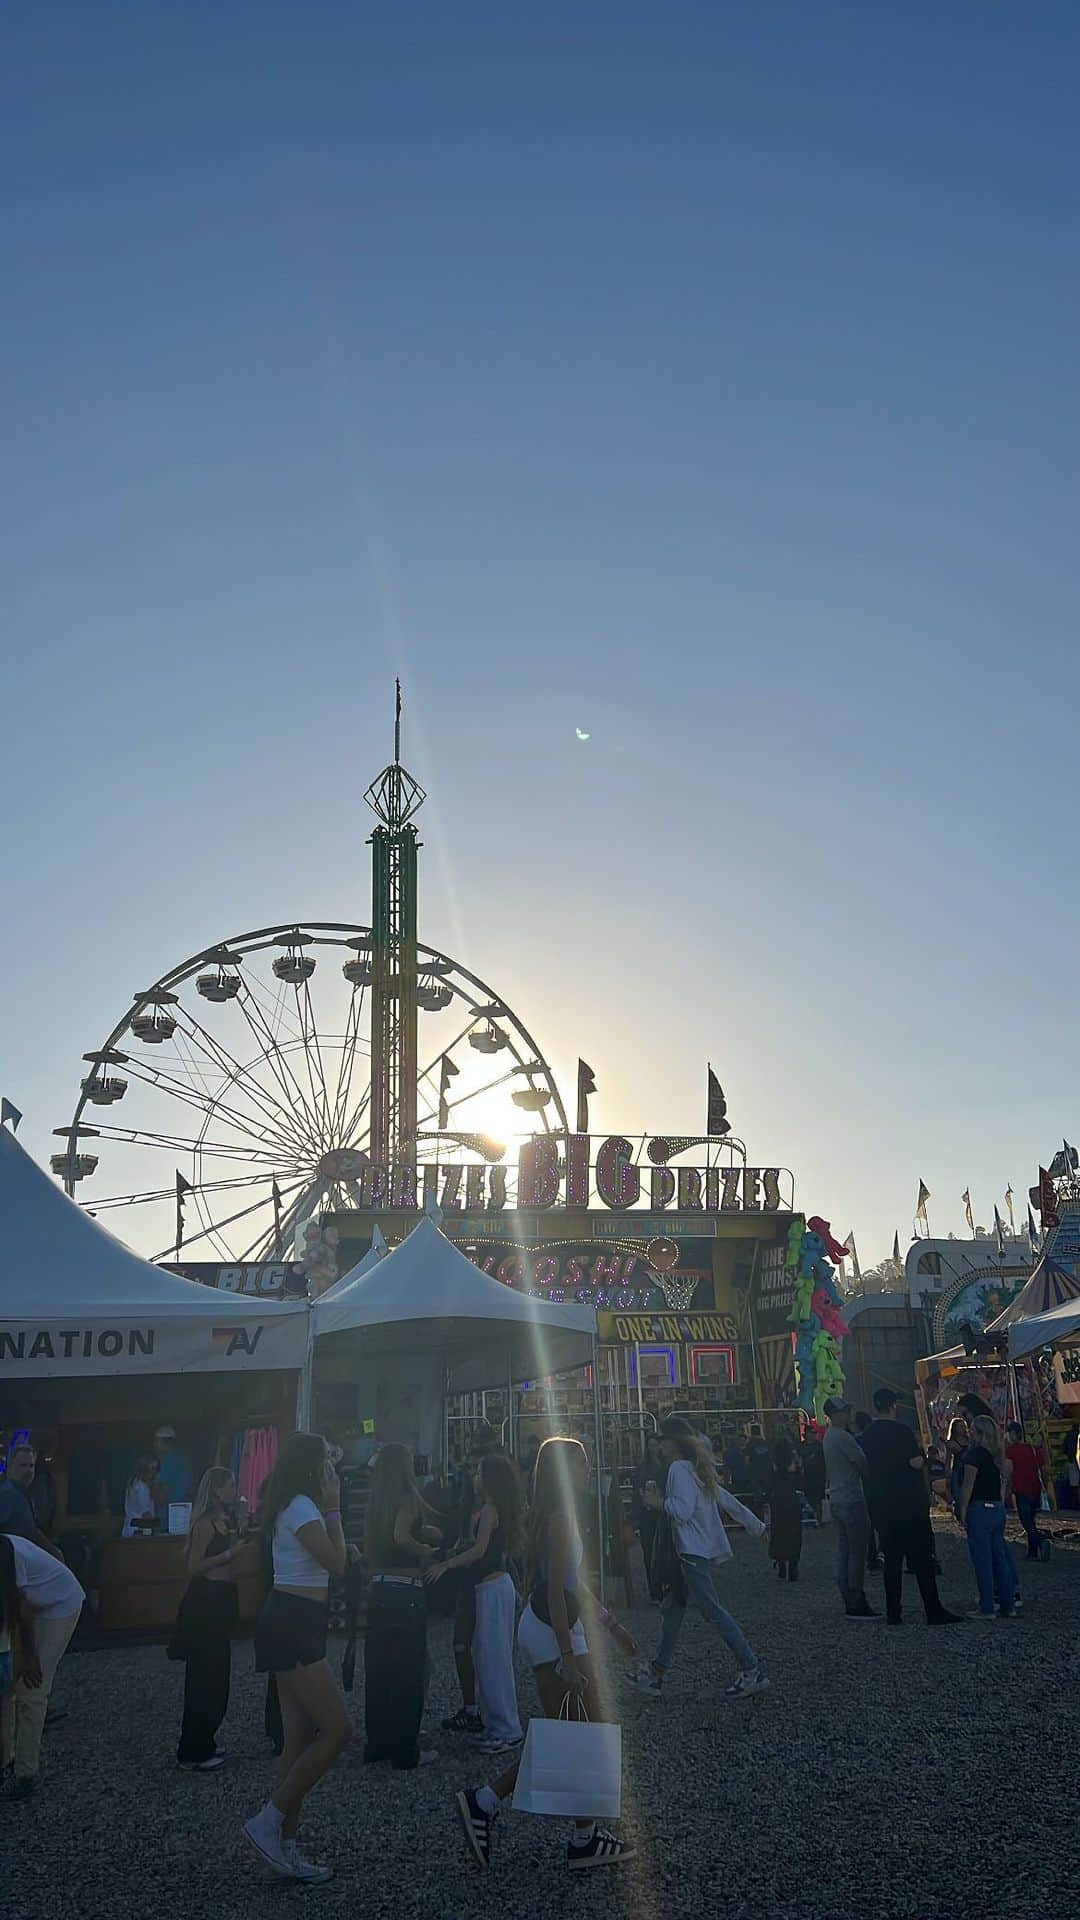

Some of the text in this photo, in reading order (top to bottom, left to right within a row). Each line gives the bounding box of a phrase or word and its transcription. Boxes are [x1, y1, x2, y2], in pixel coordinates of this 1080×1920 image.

[361, 1134, 780, 1211] PRIZES BIG PRIZES
[216, 1266, 286, 1291] BIG
[616, 1317, 738, 1341] ONE IN WINS
[0, 1329, 155, 1359] NATION
